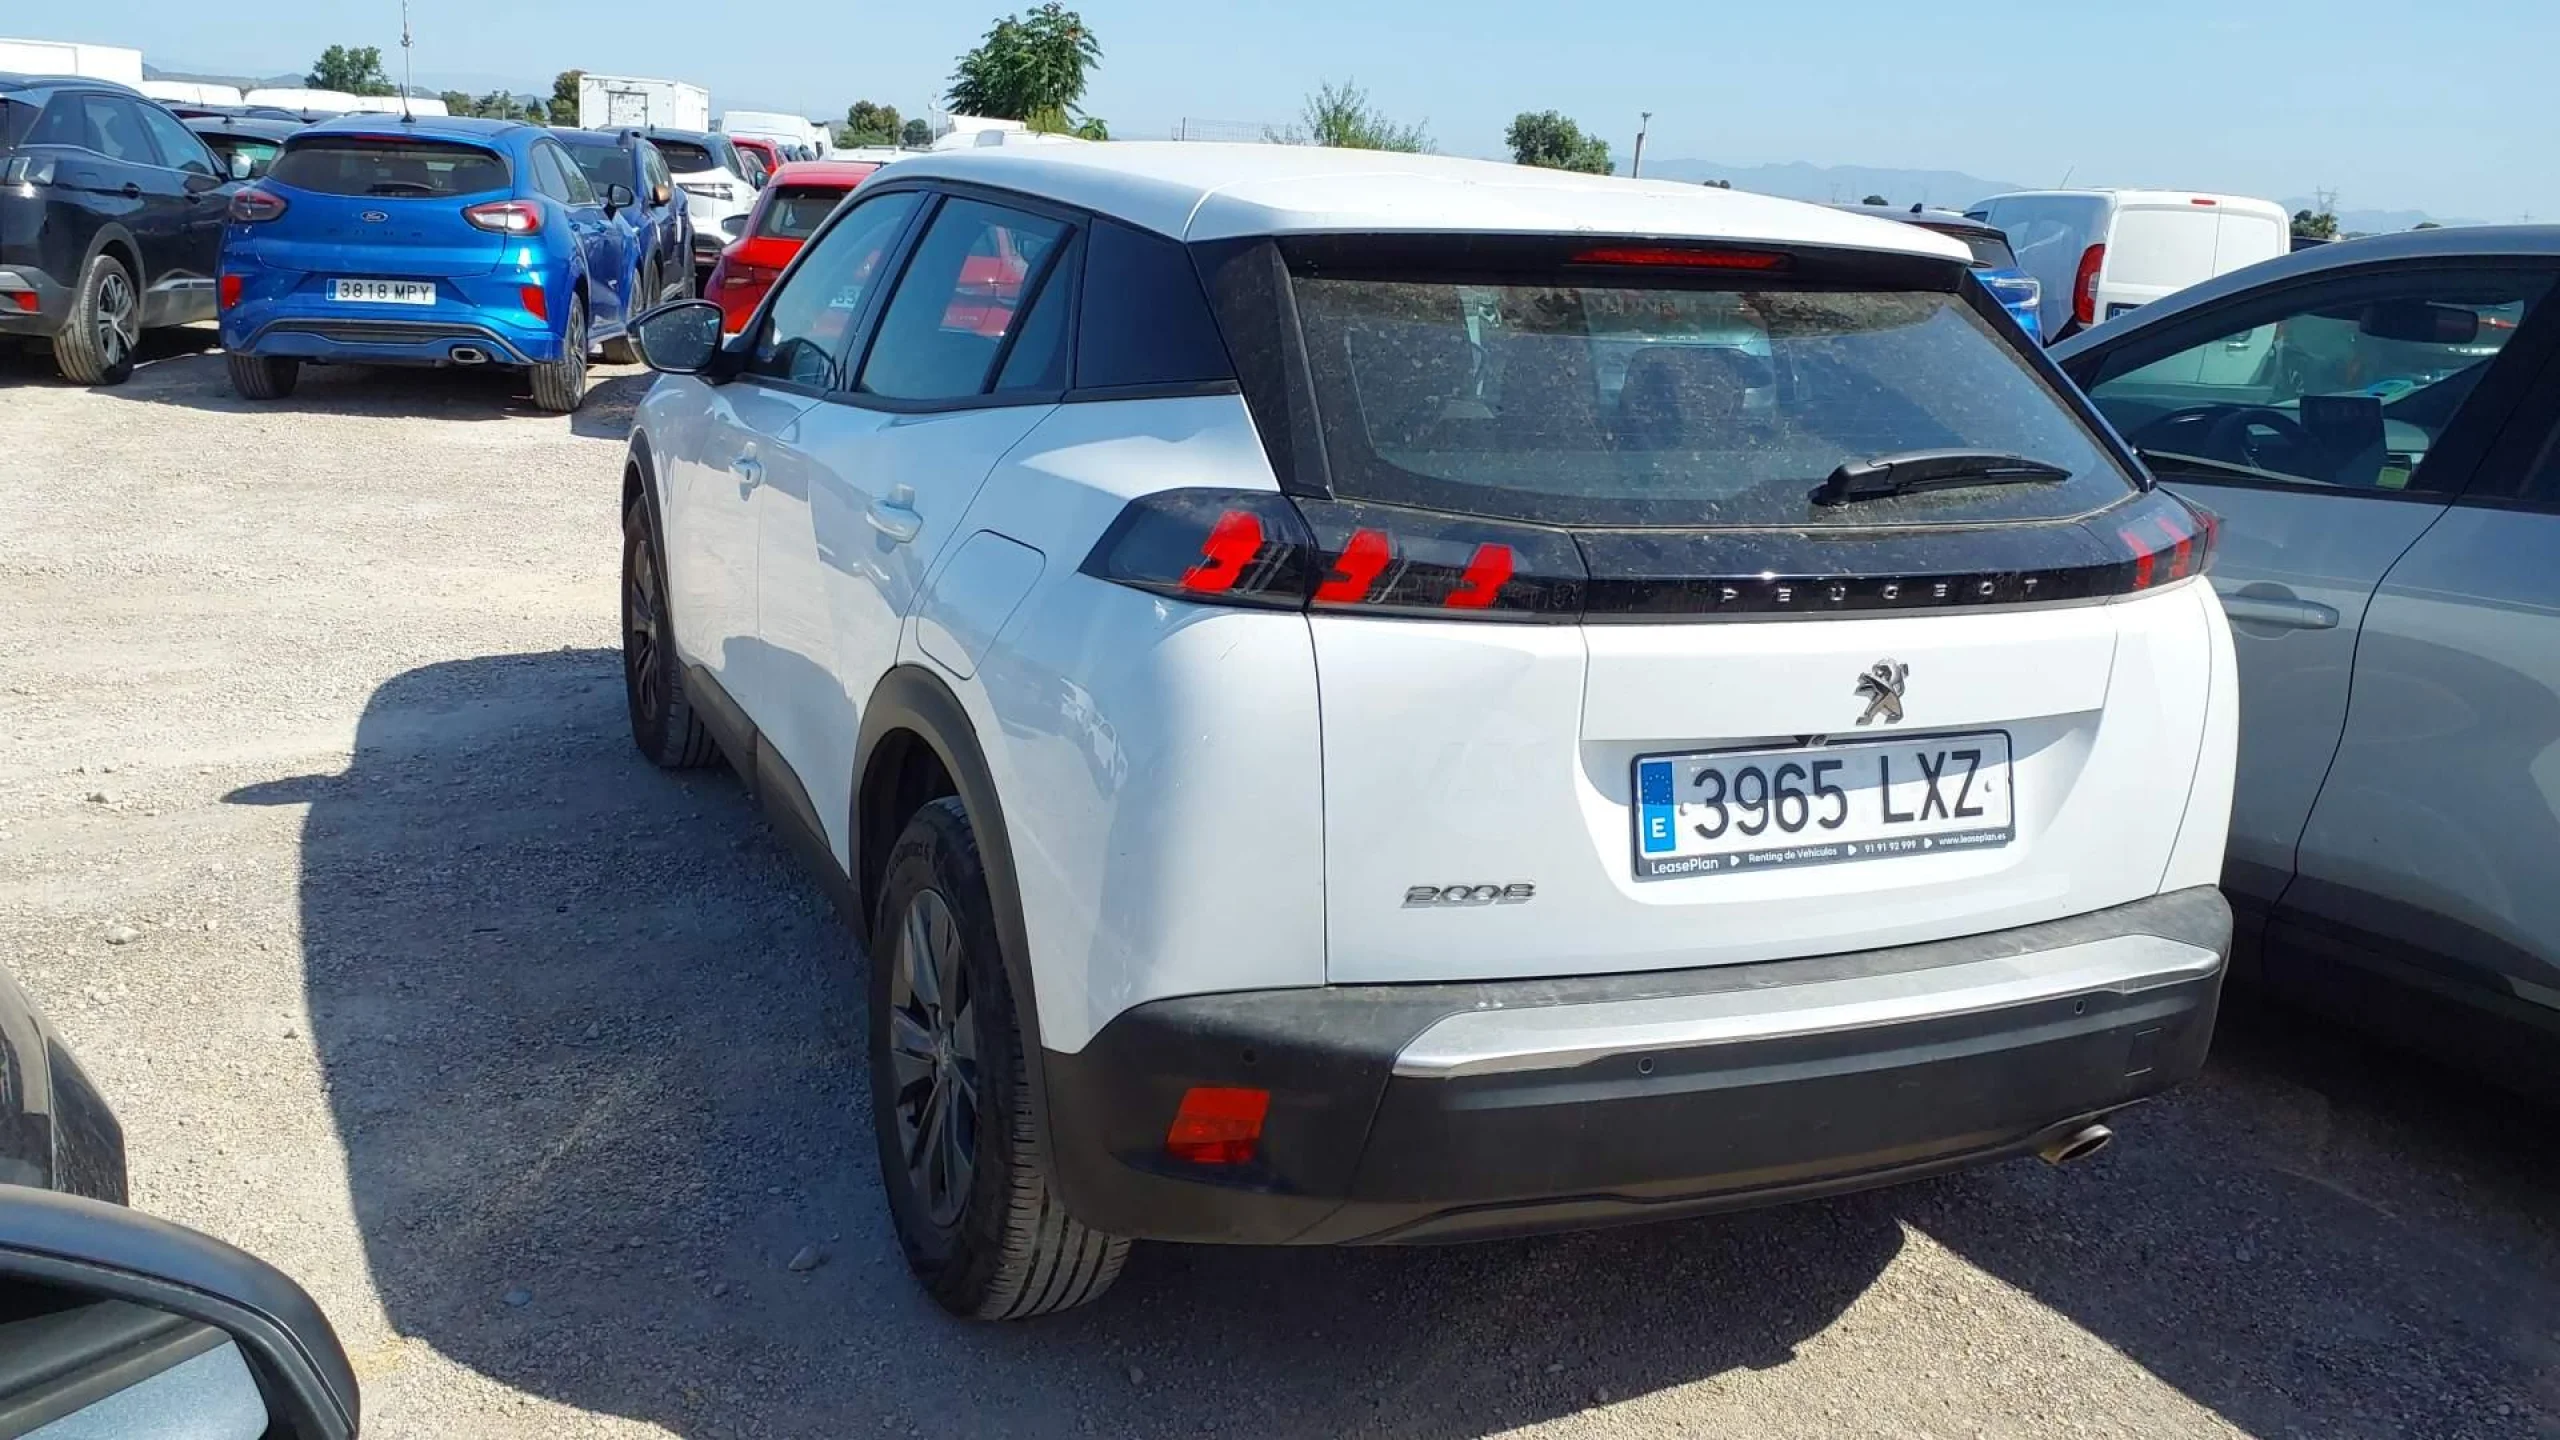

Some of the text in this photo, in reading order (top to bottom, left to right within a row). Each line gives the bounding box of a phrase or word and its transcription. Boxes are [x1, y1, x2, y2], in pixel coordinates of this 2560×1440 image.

[341, 282, 388, 299] 3818
[394, 284, 430, 301] MPY
[1721, 579, 2038, 602] PEUGEOT
[1693, 749, 1984, 840] 3965 LXZ
[1651, 816, 1667, 838] E
[1864, 839, 1917, 854] 91 91 92 999
[1939, 832, 2007, 846] www.leaseplan.es
[1749, 850, 1784, 864] Renting
[1784, 848, 1796, 861] de
[1651, 858, 1719, 875] LeasePlan
[1401, 883, 1536, 908] 2008
